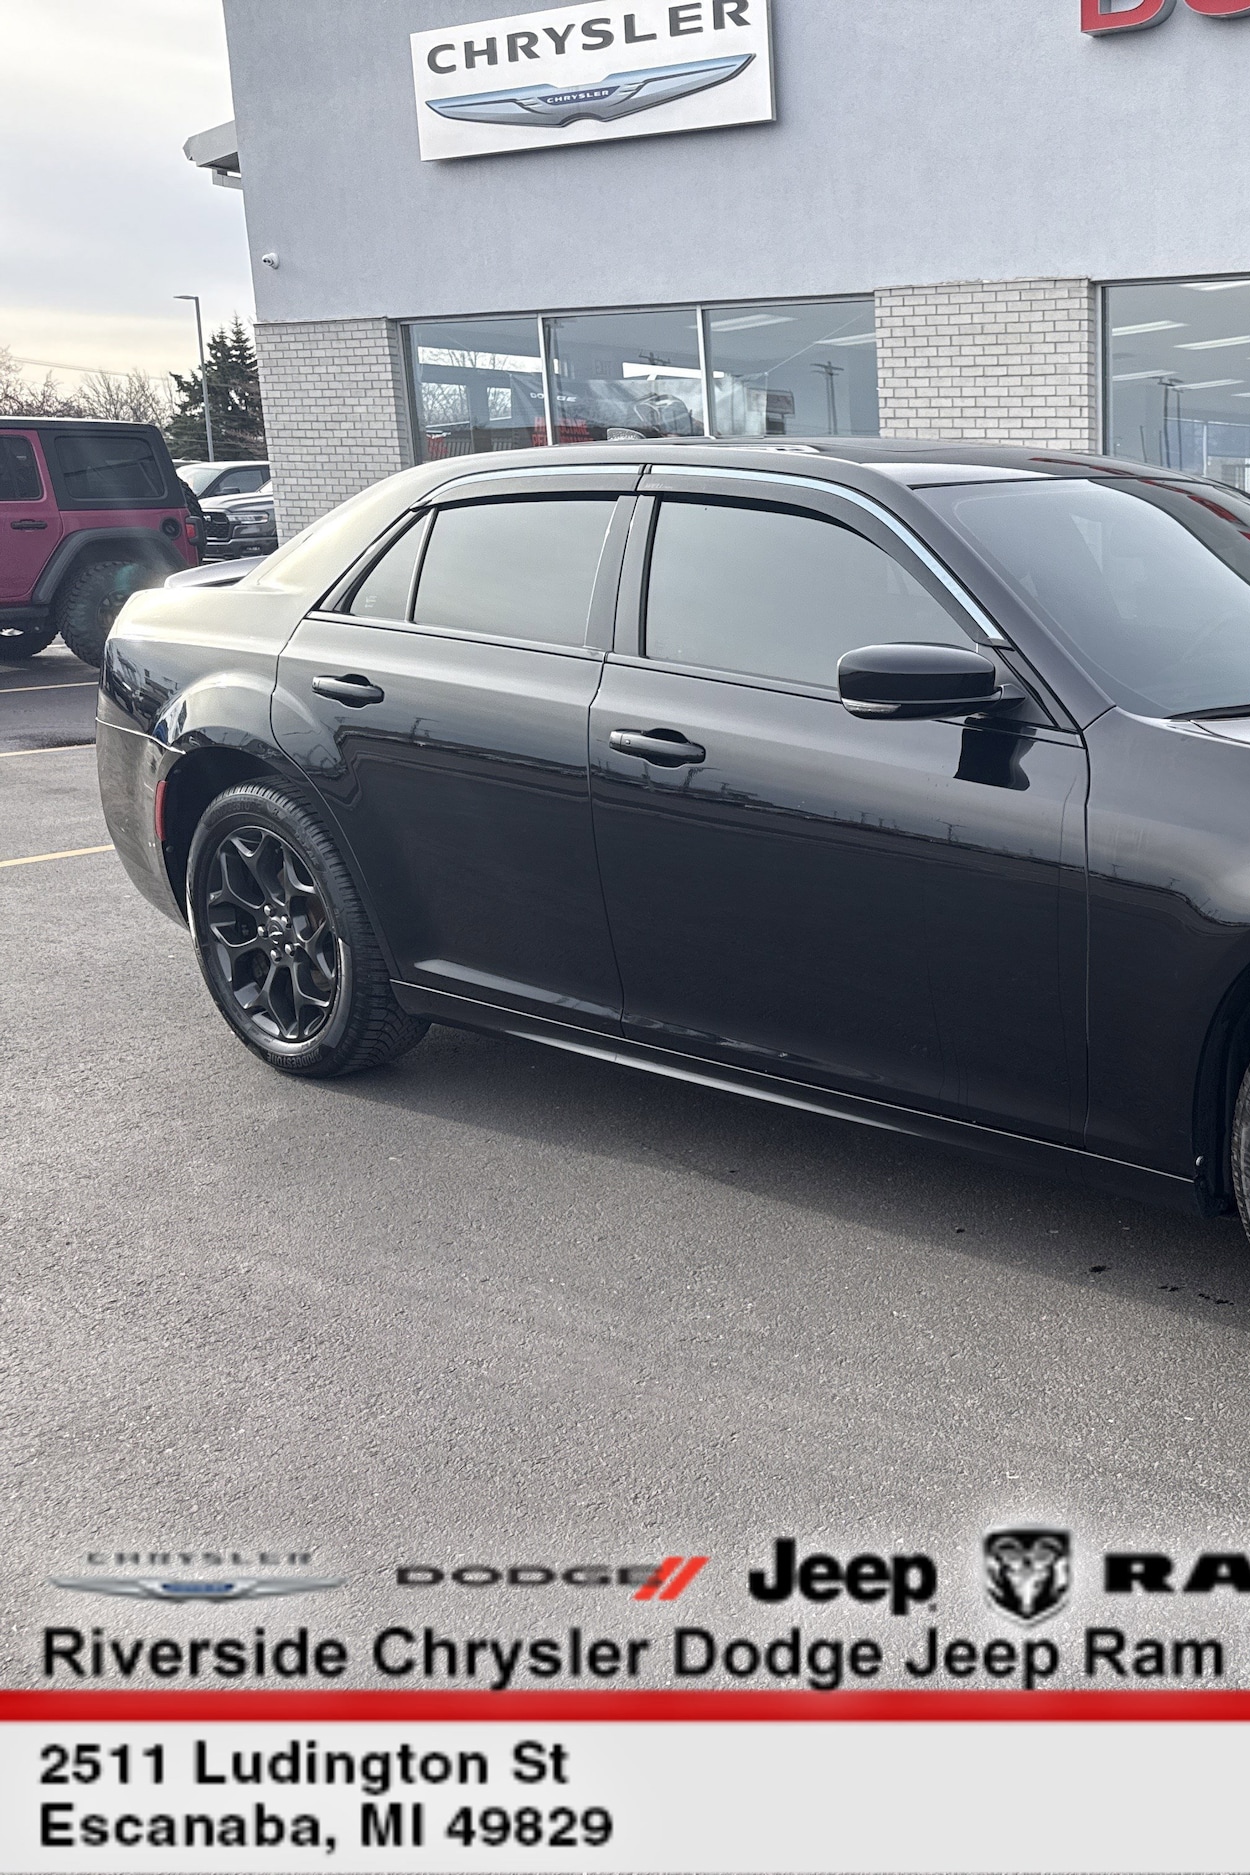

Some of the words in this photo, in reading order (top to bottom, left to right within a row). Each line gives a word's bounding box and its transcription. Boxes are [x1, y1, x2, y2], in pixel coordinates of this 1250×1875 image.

[427, 0, 752, 74] CHRYSLER
[546, 90, 609, 104] CHRYSLER
[529, 391, 577, 402] DOGE
